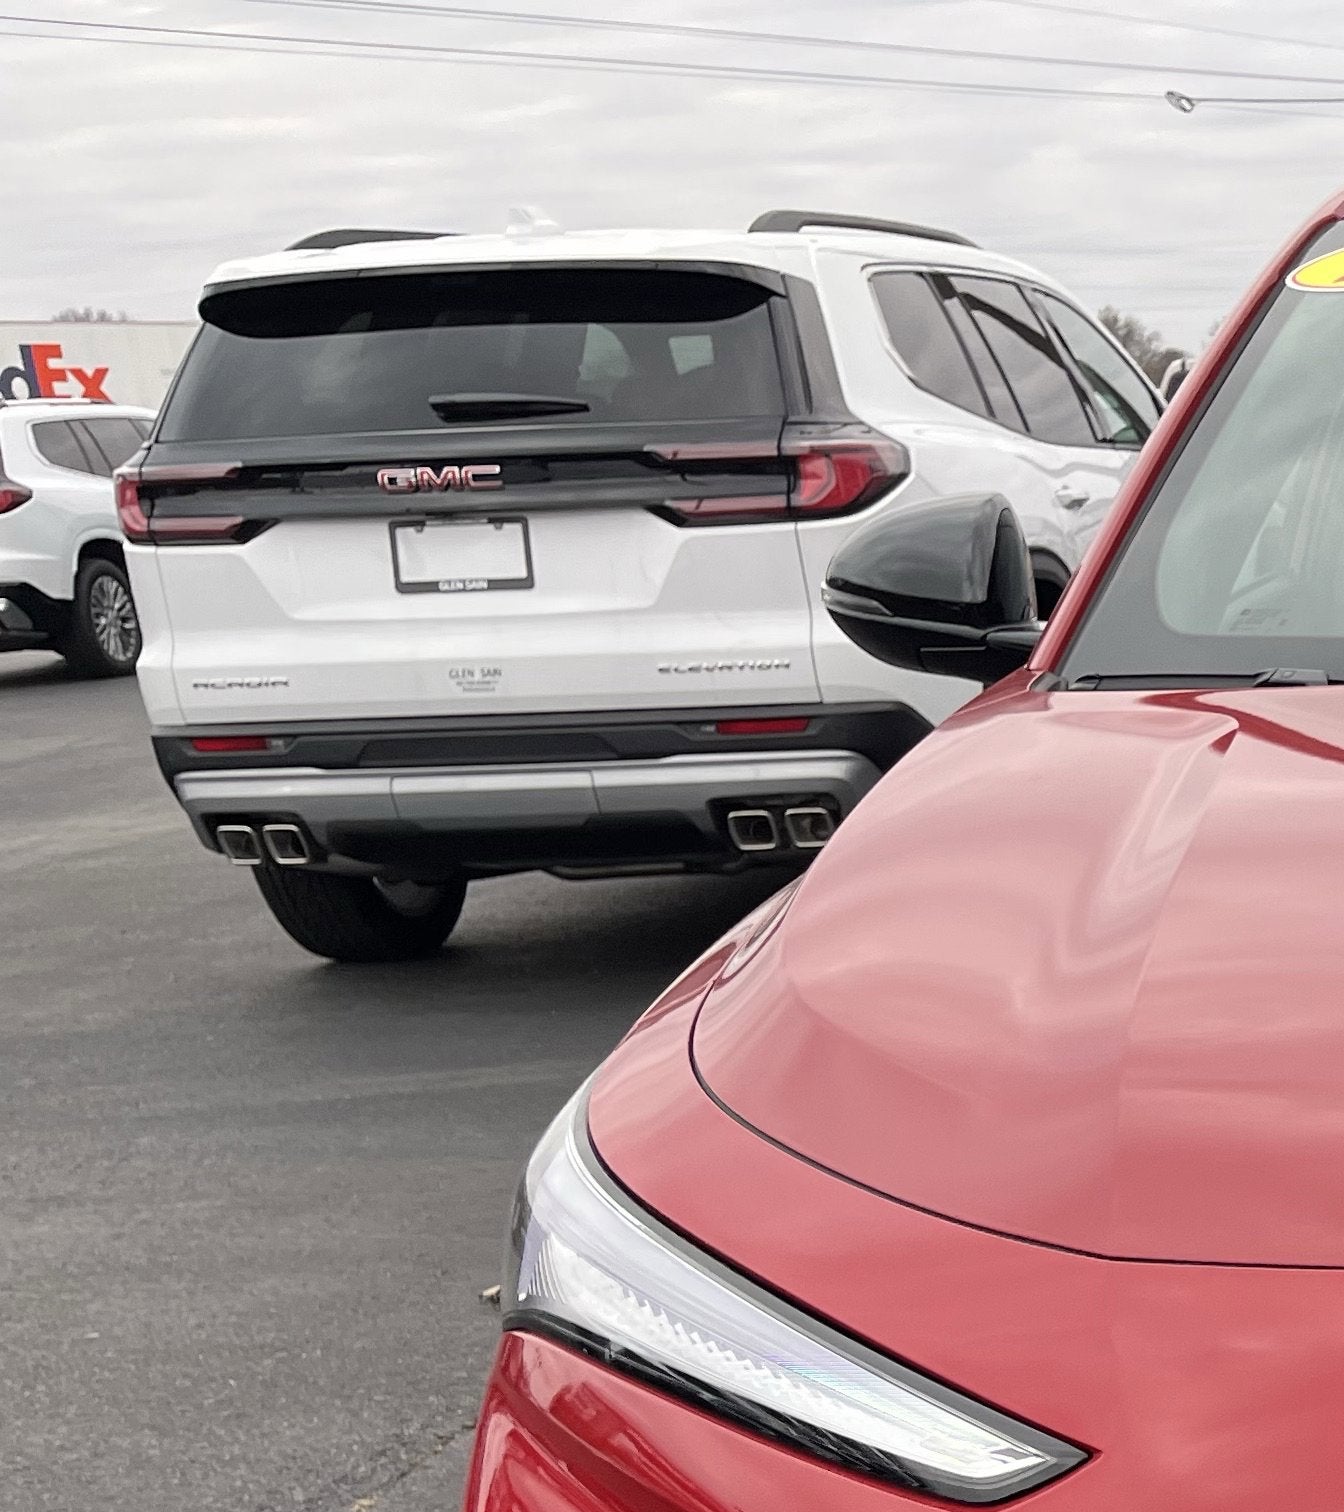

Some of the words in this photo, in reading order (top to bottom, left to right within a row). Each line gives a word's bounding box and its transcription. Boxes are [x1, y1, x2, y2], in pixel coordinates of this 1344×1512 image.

[377, 465, 503, 494] GMC
[656, 660, 791, 674] ELEVATION
[192, 676, 290, 690] ACADIA
